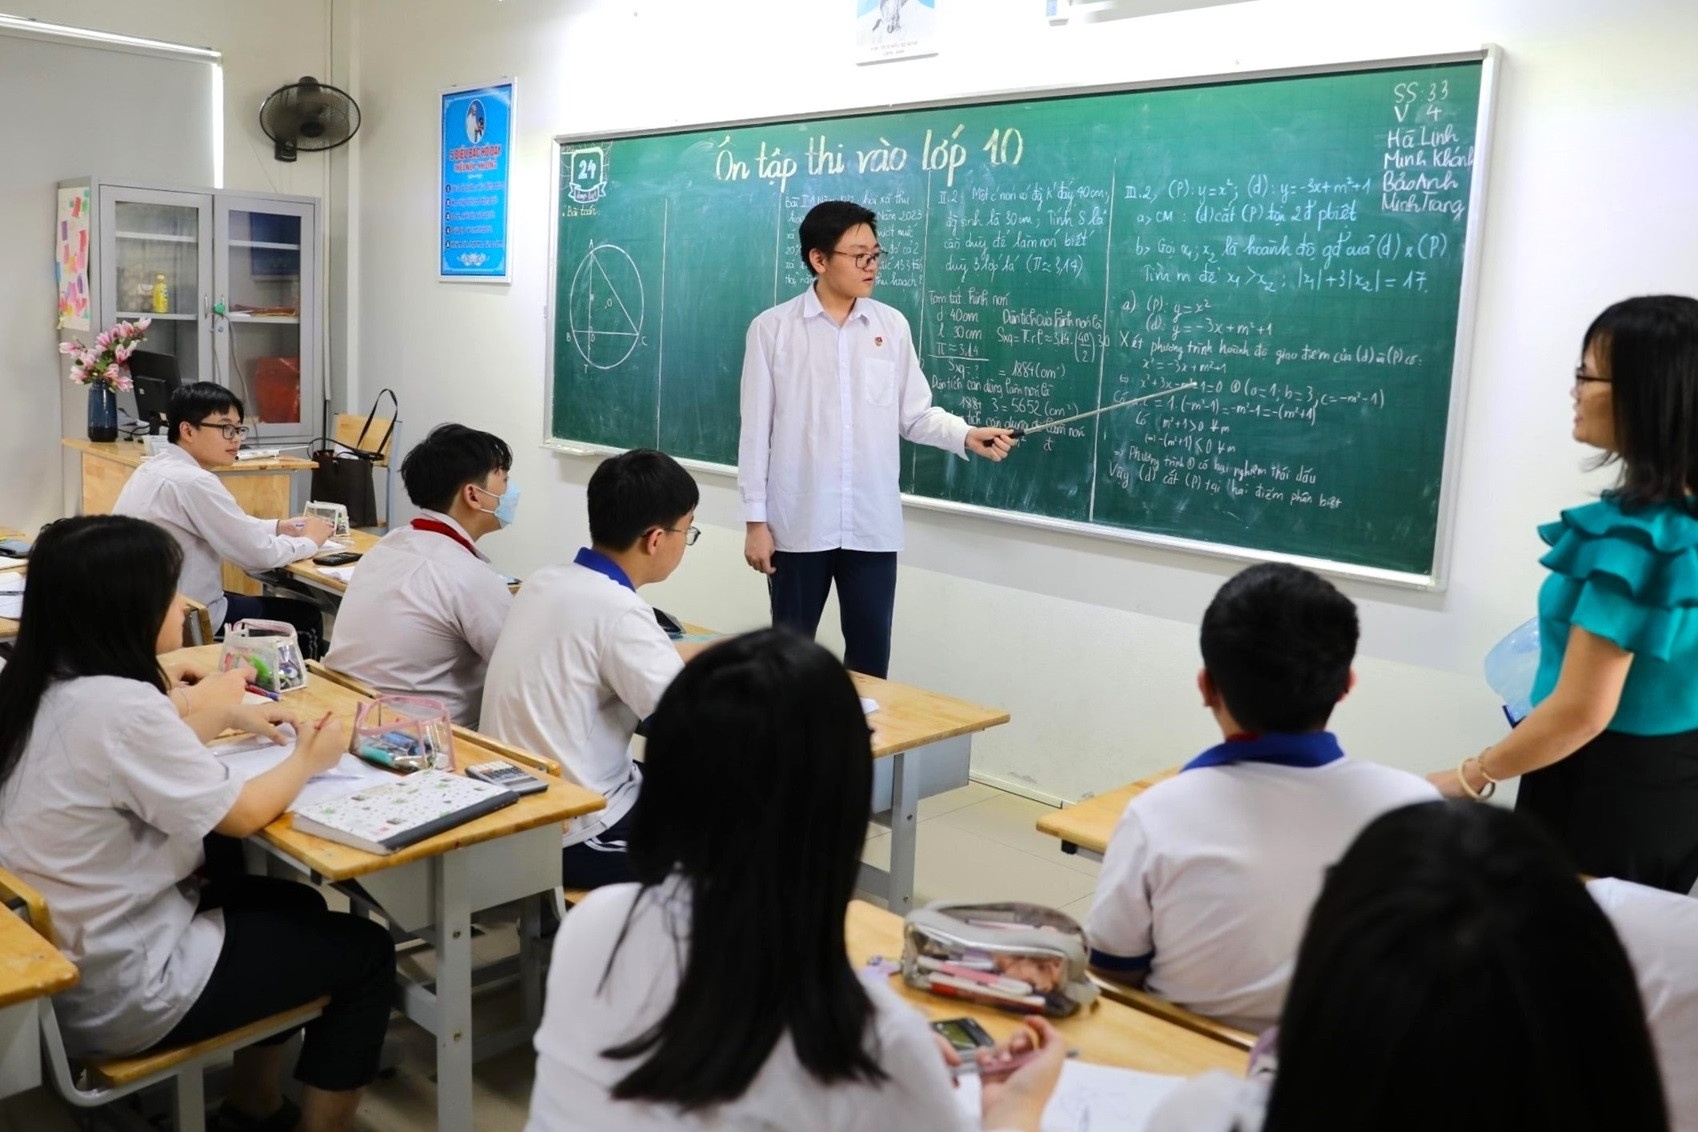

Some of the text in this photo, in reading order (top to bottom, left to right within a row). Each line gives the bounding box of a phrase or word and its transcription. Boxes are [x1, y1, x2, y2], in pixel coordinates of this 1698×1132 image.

[1426, 104, 1442, 121] 4
[1421, 124, 1459, 147] Linh
[716, 124, 1023, 192] Ôn tập thi vào lớp 10
[1384, 146, 1474, 169] Minh Khánh
[578, 159, 597, 179] 24
[1415, 170, 1458, 190] Anh
[899, 210, 923, 221] 2023
[1382, 191, 1465, 221] Minh Trang
